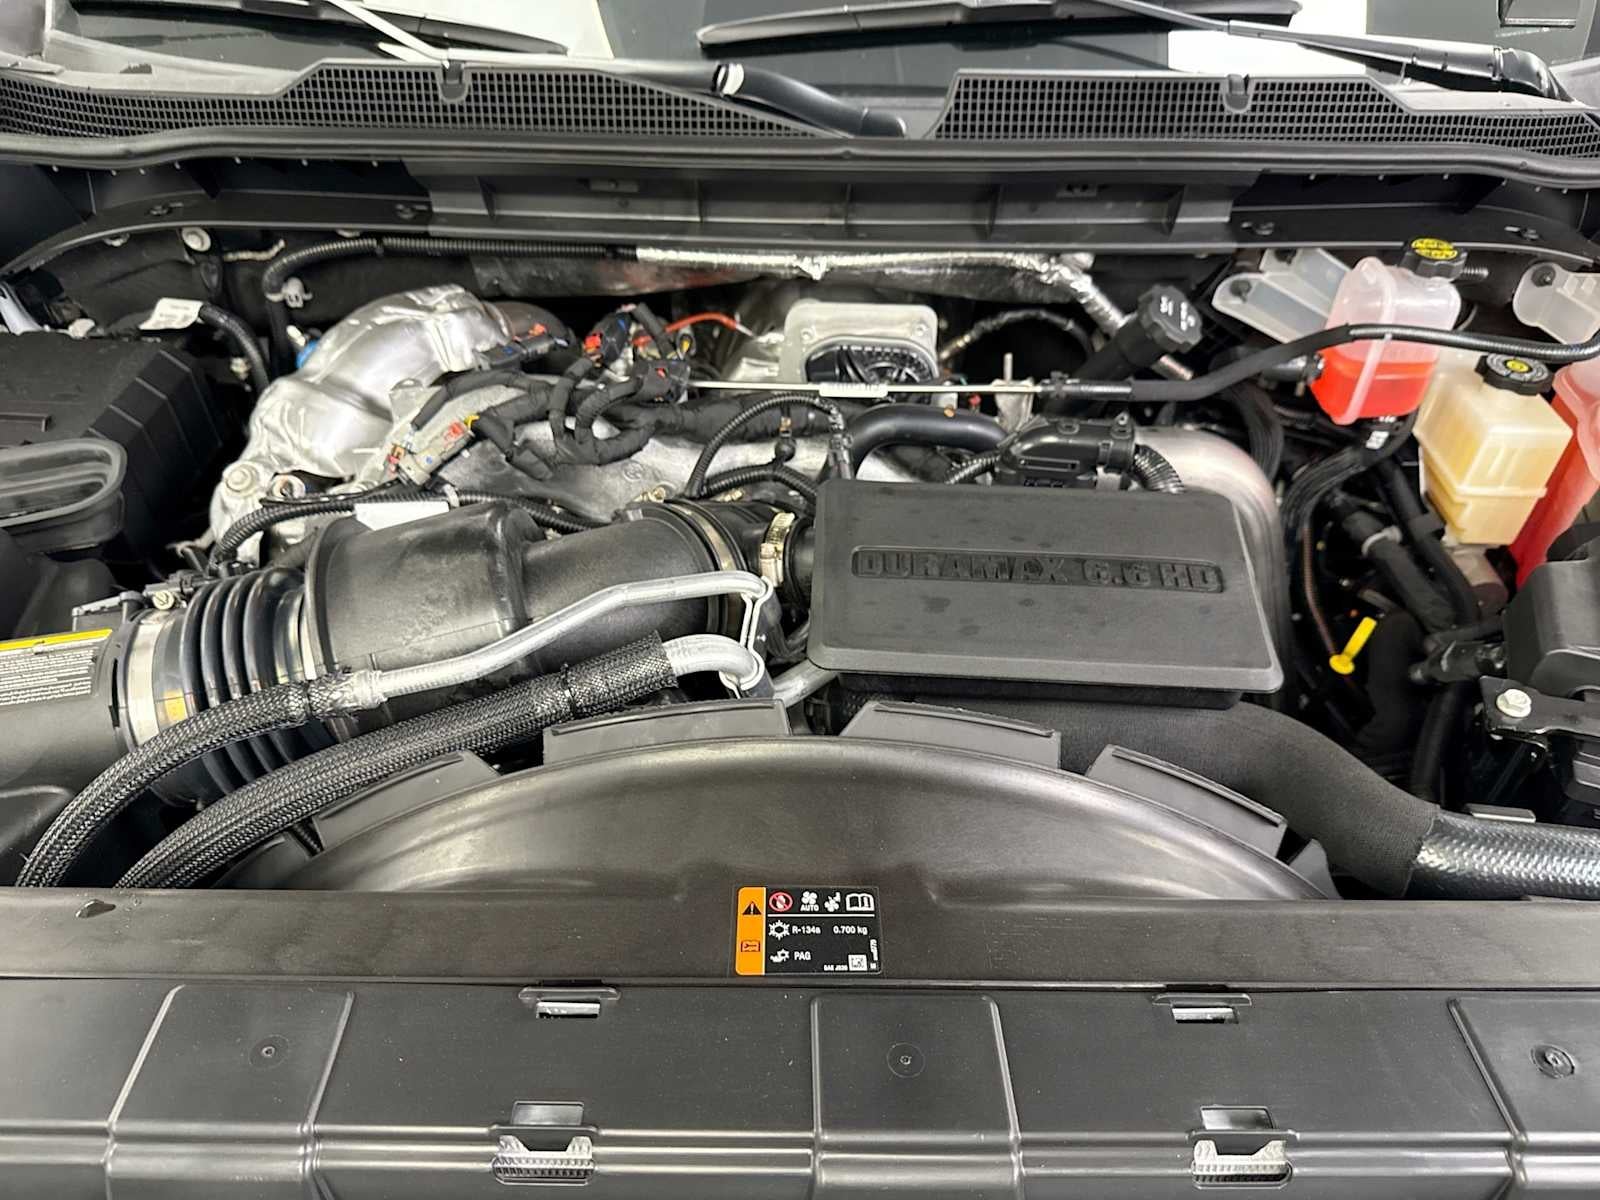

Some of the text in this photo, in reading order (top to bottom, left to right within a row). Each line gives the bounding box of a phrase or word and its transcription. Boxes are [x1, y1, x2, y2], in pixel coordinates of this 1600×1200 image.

[857, 551, 1218, 591] DURAMAX 6.6 HD
[800, 904, 819, 912] AUTO
[791, 926, 868, 935] R-134a 0.700 kg
[793, 951, 811, 960] PAG
